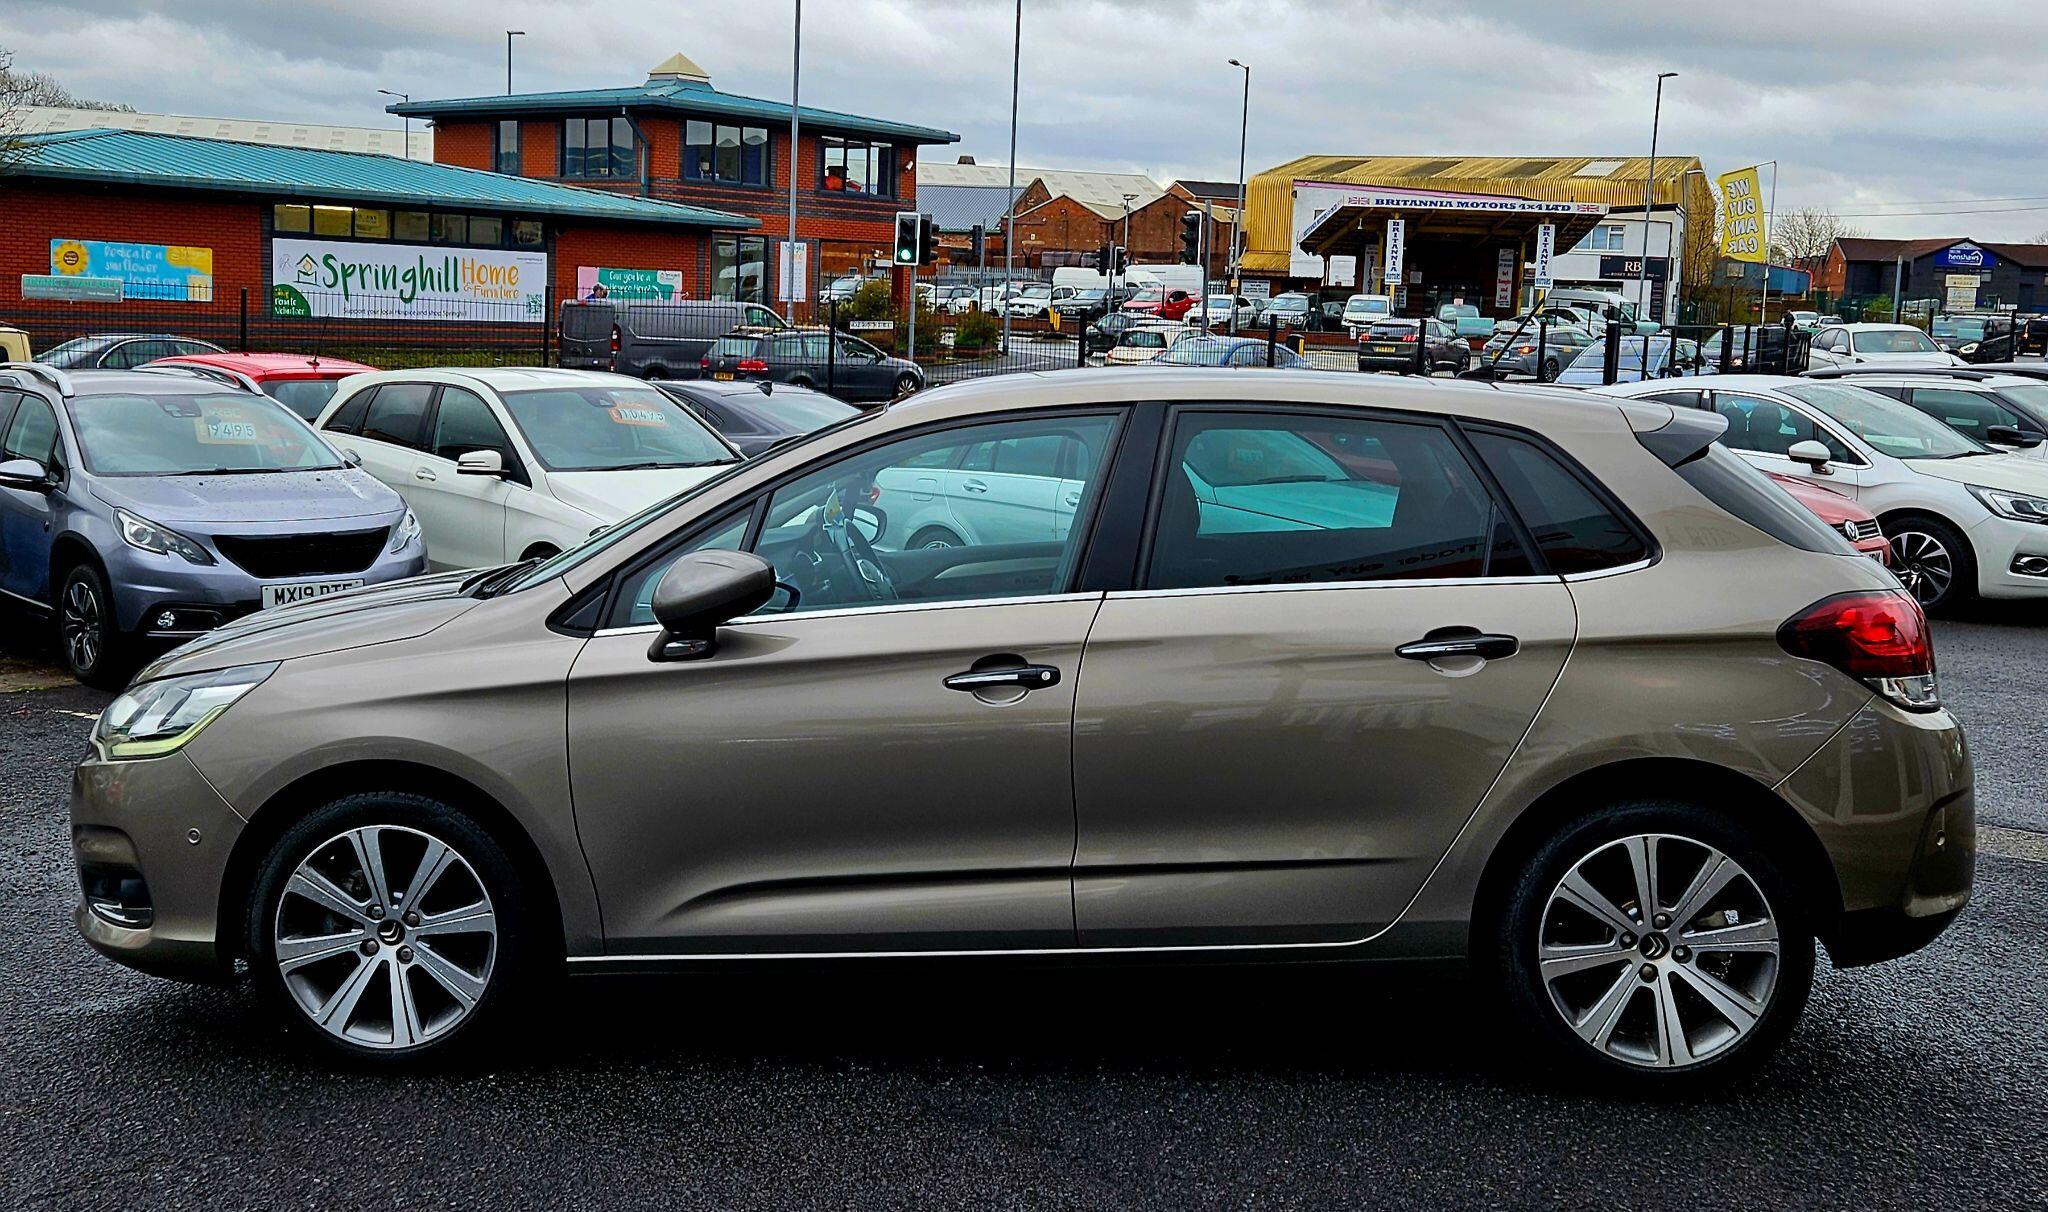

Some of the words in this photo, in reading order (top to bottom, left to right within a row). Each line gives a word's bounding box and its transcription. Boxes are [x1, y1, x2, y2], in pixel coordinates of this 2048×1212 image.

[1375, 198, 1453, 207] BRITANNIA
[1457, 201, 1516, 210] MOTORS
[1519, 203, 1542, 211] 4x4
[1545, 204, 1571, 212] LTD
[1390, 221, 1400, 272] BRITANNIA
[1540, 226, 1550, 276] BRITANNIA
[1624, 261, 1642, 272] RB
[23, 277, 67, 287] FINANCE
[322, 253, 459, 304] Springhill
[462, 257, 518, 286] Home
[473, 284, 519, 300] Furniture
